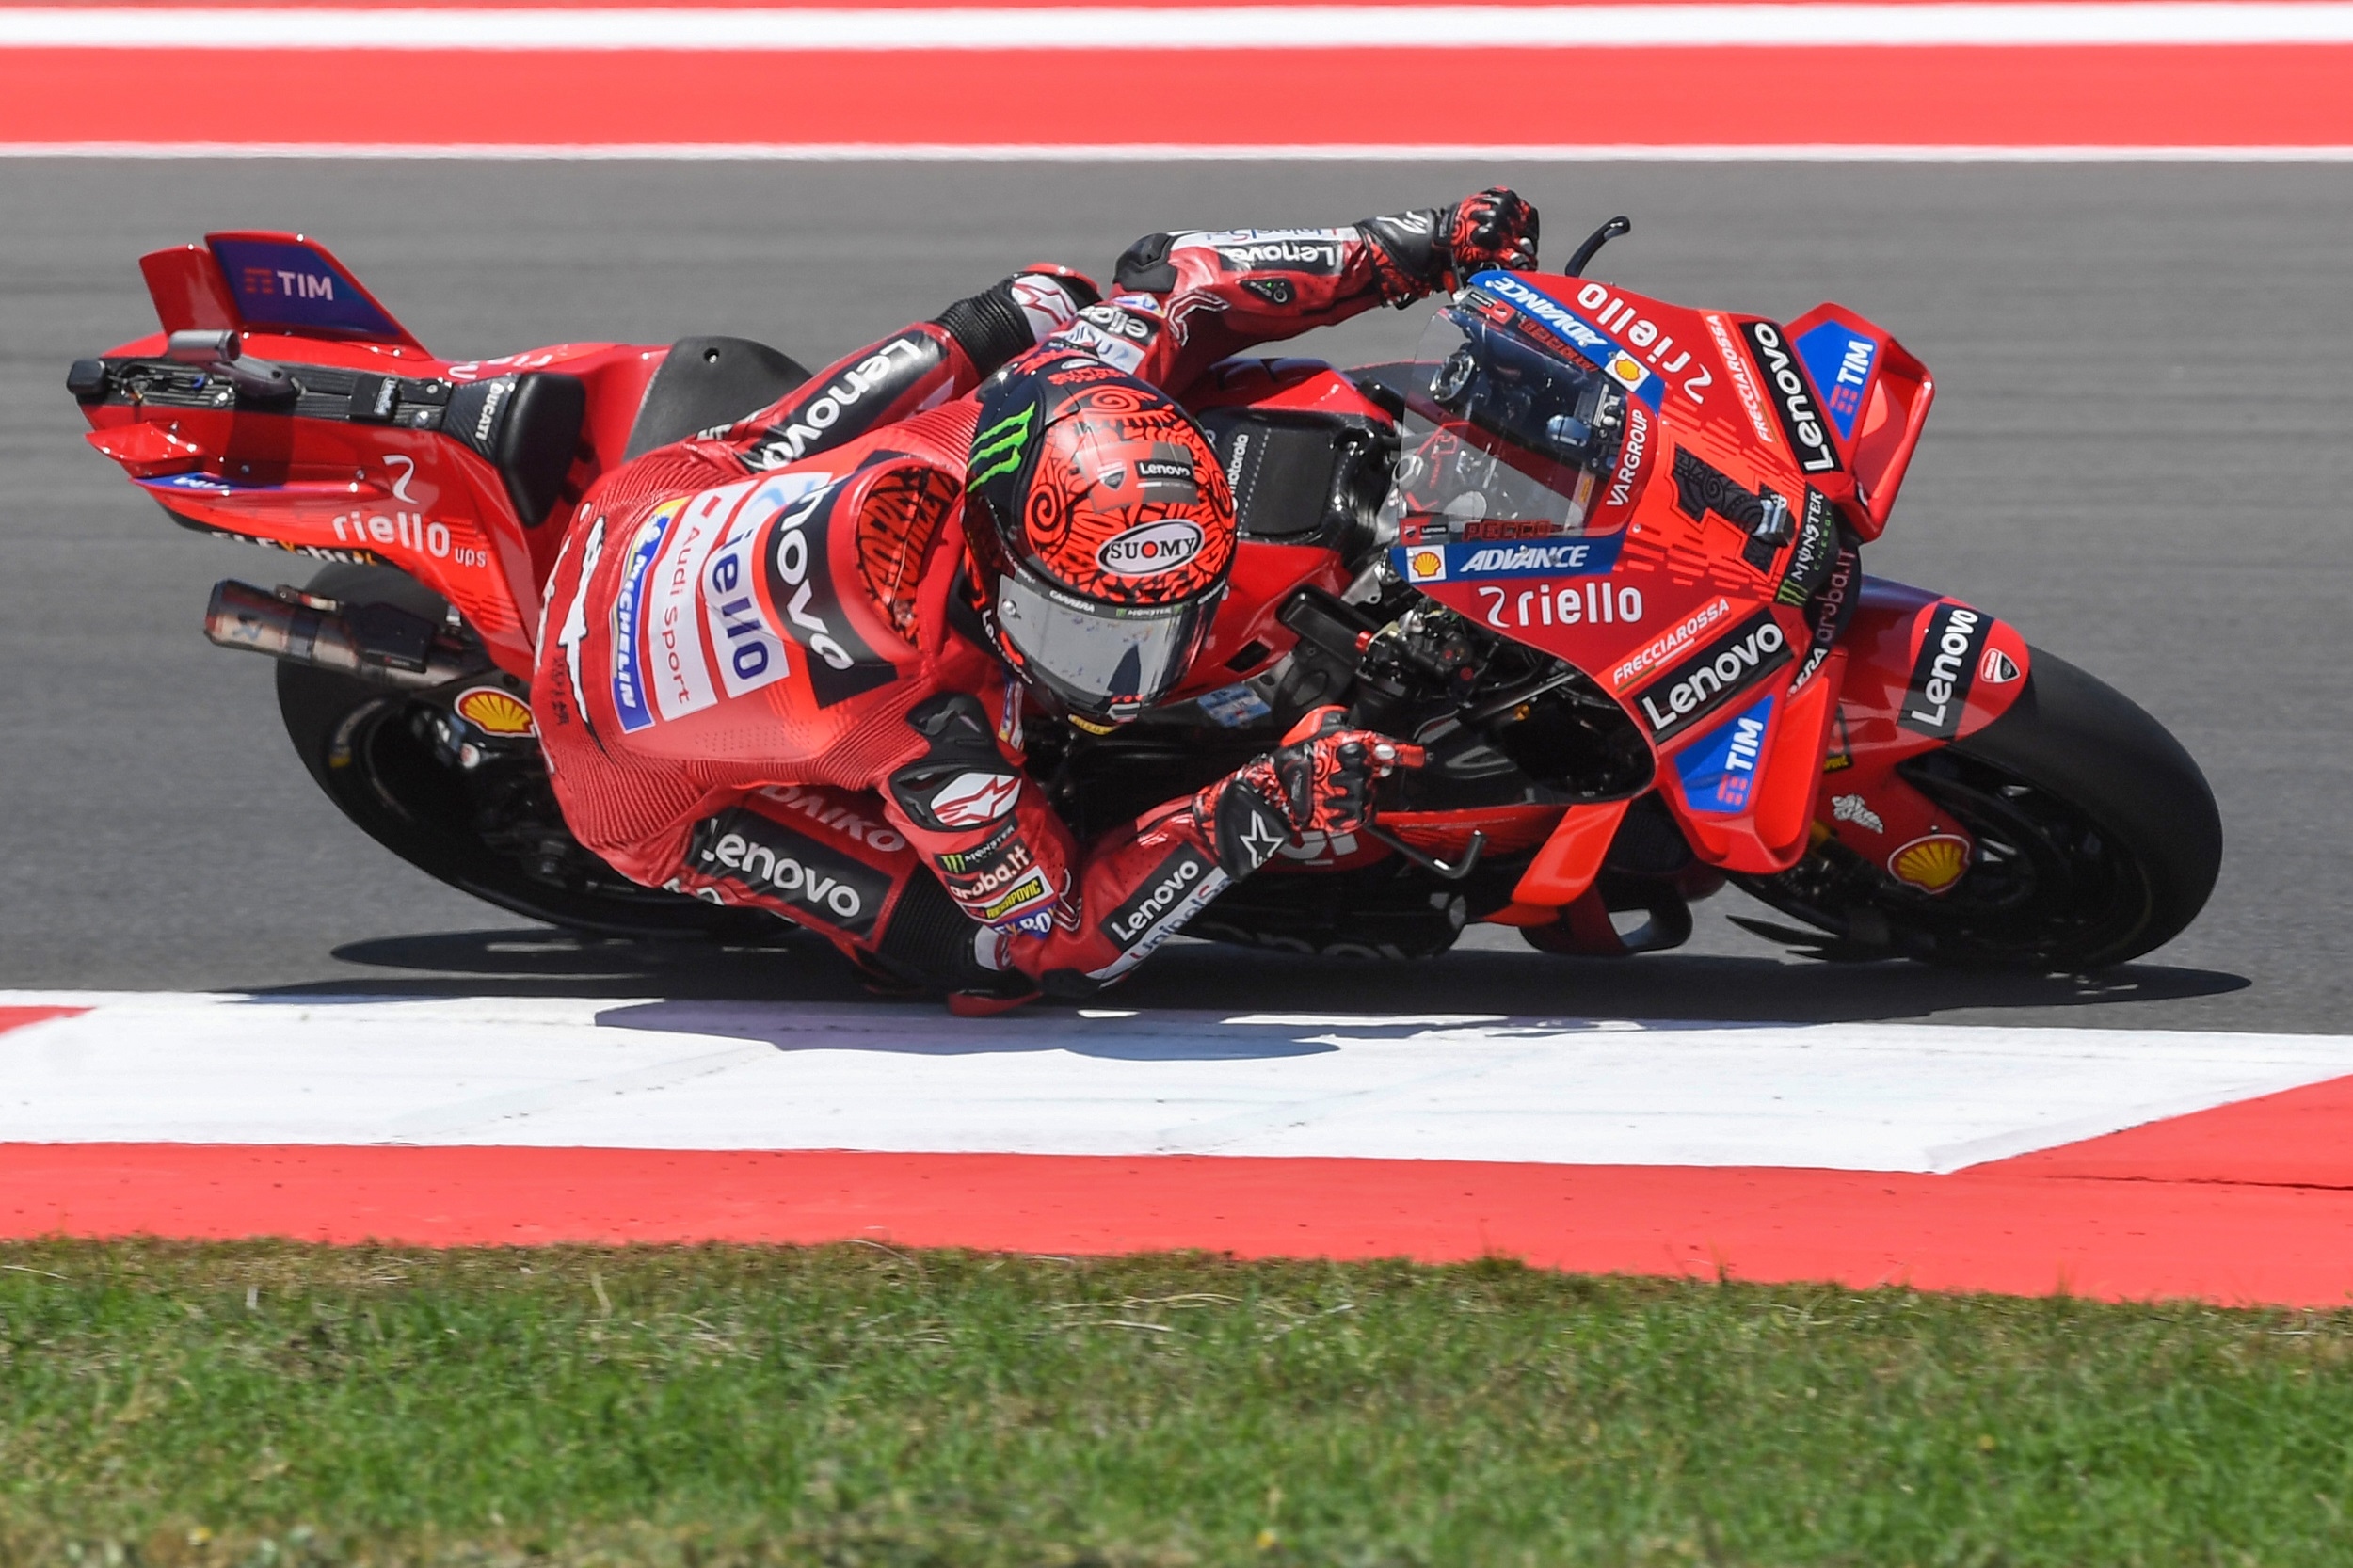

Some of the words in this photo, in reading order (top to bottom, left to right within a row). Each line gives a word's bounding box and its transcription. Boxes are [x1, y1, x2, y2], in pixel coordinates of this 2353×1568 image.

[277, 270, 334, 301] TIM
[1493, 276, 1609, 346] ADVANCE
[1577, 281, 1693, 374] riello
[1837, 339, 1875, 386] TIM
[474, 381, 505, 440] DUCATI
[761, 337, 923, 471] Lenovo
[1705, 314, 1774, 443] FRECCIAROSSA
[1753, 322, 1835, 471] Lenovo
[1138, 461, 1191, 477] Lenovo
[1226, 433, 1250, 496] motorola
[331, 510, 452, 558] riello
[454, 547, 488, 568] ups
[670, 526, 702, 597] Audi
[1109, 536, 1195, 559] SUOMY
[1420, 525, 1448, 534] Lenovo
[1459, 544, 1591, 573] ADVANCE
[1790, 490, 1825, 582] MONSTER
[1813, 509, 1833, 572] ENERGY
[712, 529, 770, 680] iello
[776, 482, 854, 671] novo
[1049, 589, 1096, 613] CARRERA
[1517, 581, 1644, 628] riello
[618, 554, 648, 709] MICHELIN
[662, 605, 691, 705] Sport
[1612, 597, 1731, 686] FRECCIAROSSA
[1641, 622, 1784, 731] Lenovo
[1911, 608, 1979, 728] Lenovo
[1725, 716, 1765, 773] TIM
[964, 824, 1016, 863] MONSTER
[1111, 860, 1200, 942] Lenovo
[1129, 876, 1232, 960] UnipolS
